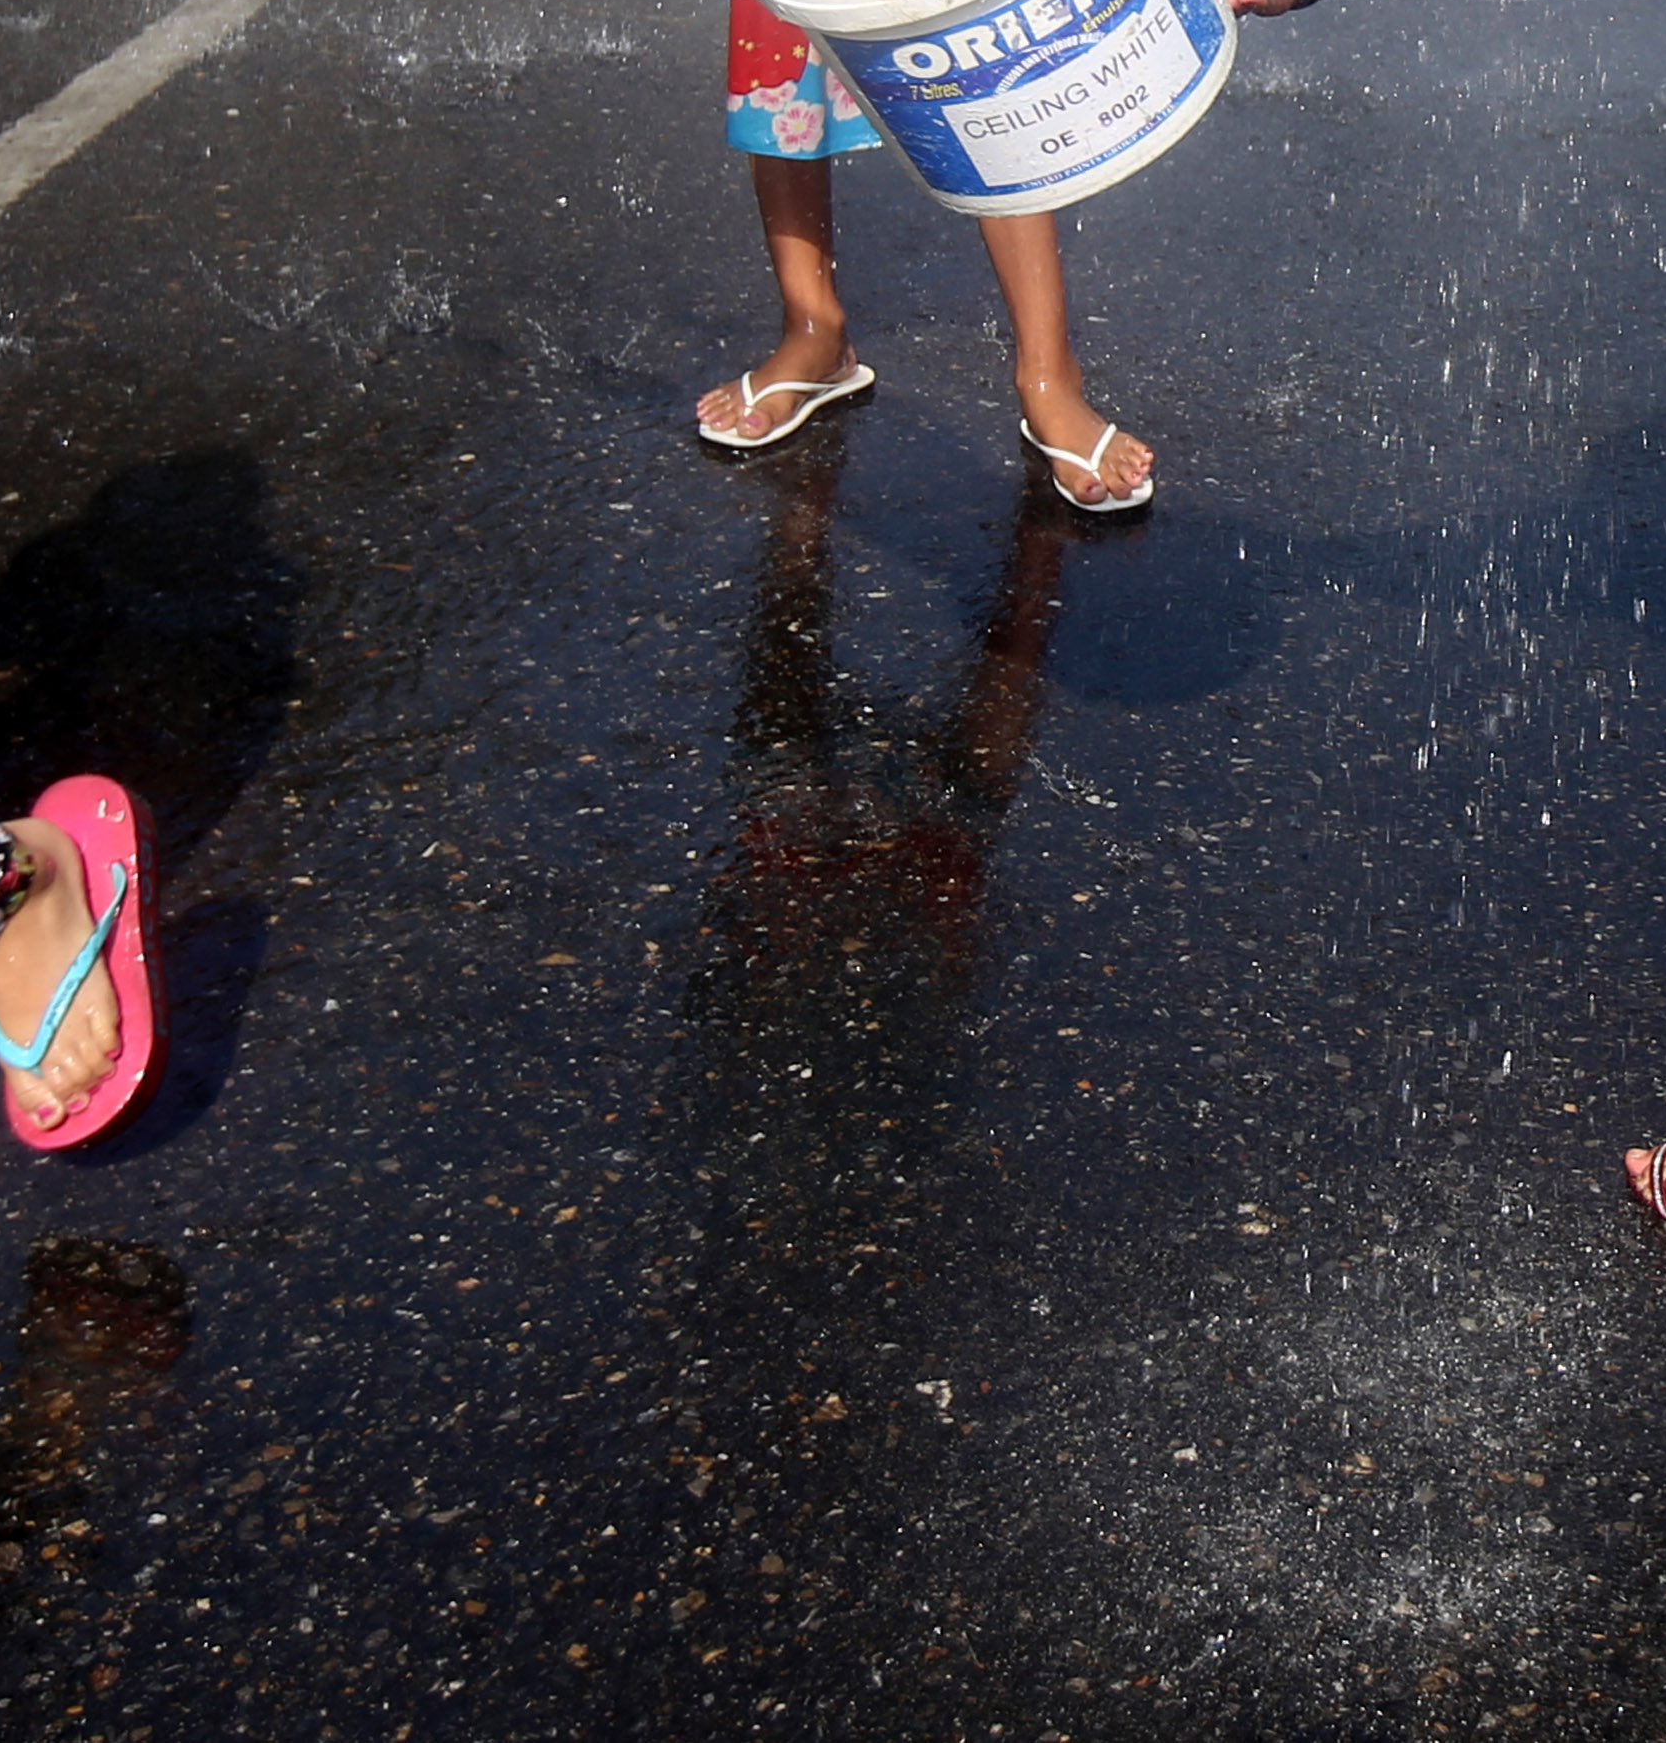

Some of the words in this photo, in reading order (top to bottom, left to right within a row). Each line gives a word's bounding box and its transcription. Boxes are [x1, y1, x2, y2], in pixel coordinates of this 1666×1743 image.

[963, 82, 1090, 139] CEILING
[1091, 6, 1173, 87] WHITE
[1040, 130, 1079, 154] OE
[1098, 85, 1150, 127] 8002
